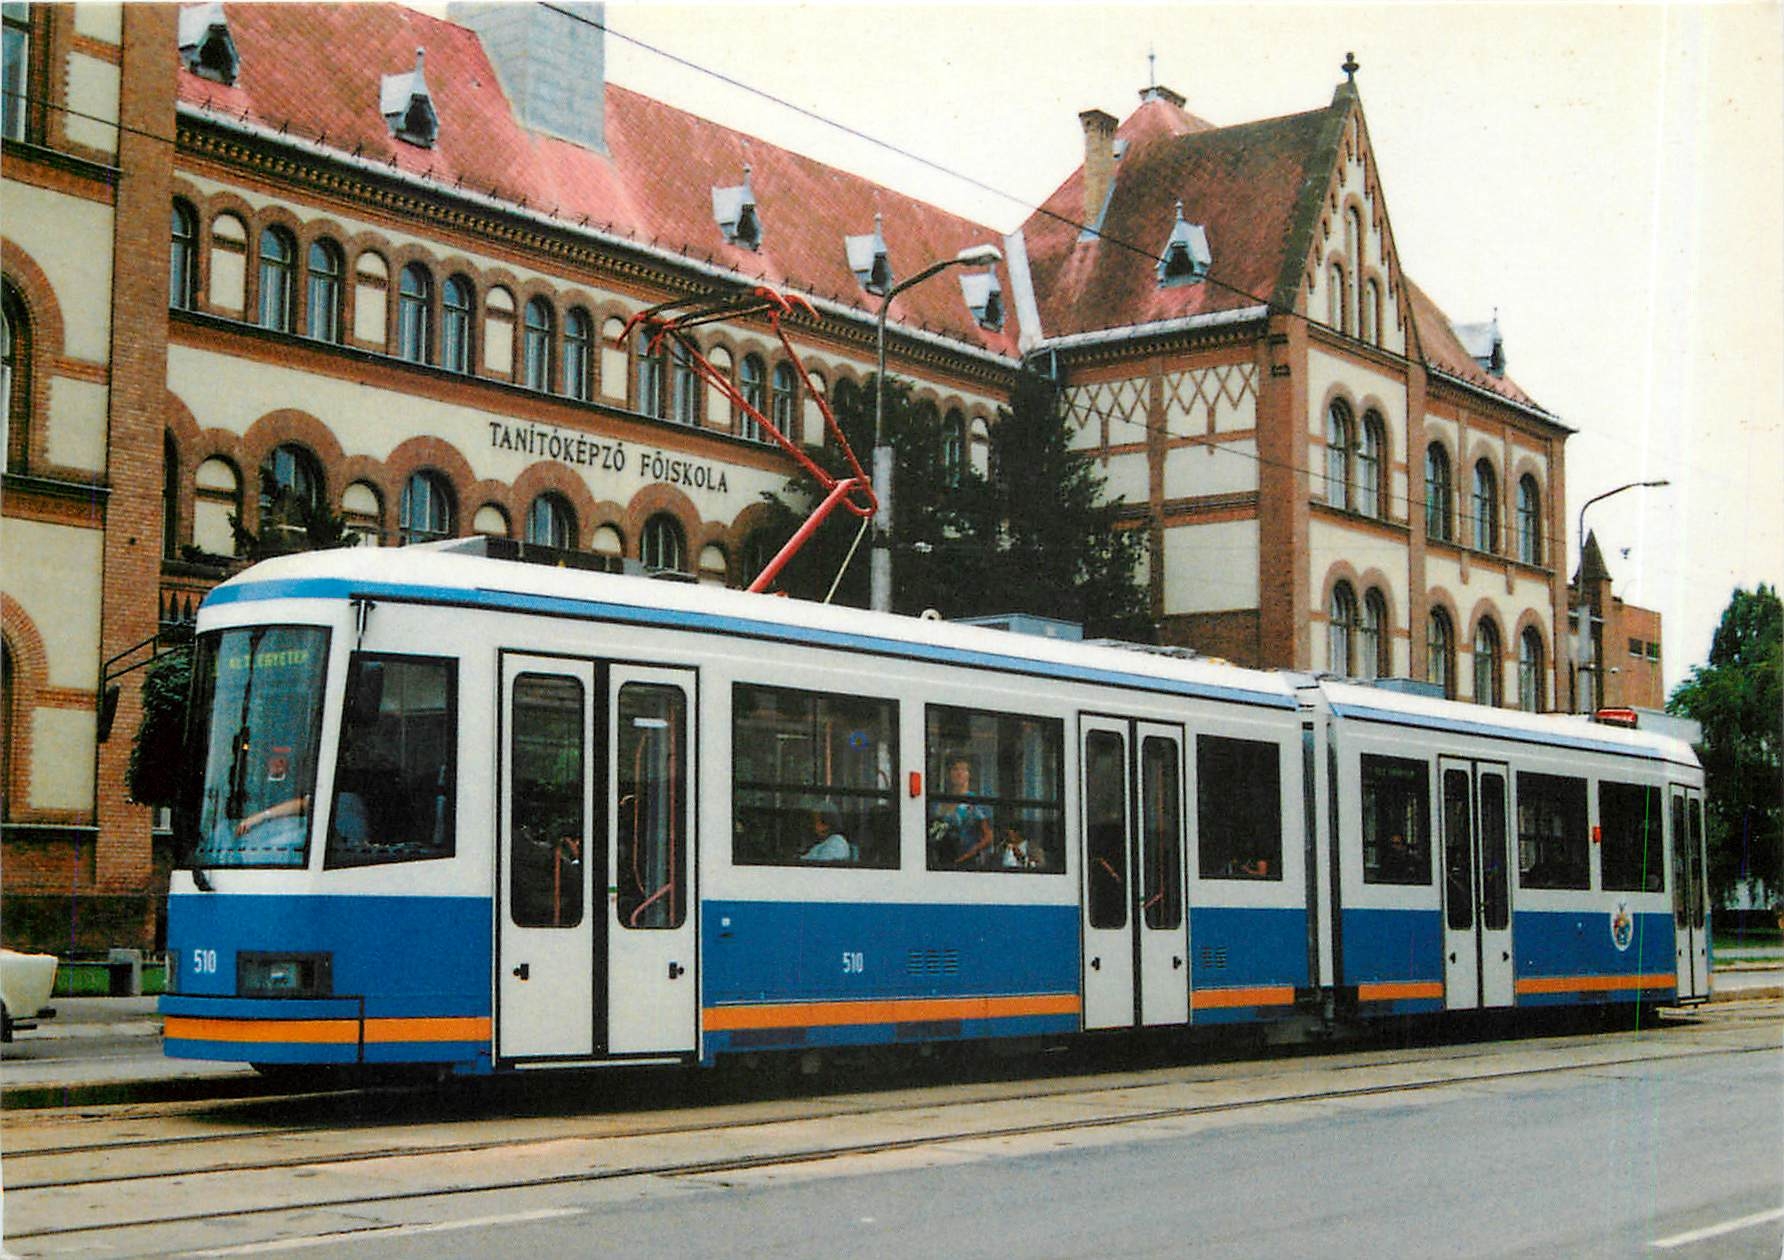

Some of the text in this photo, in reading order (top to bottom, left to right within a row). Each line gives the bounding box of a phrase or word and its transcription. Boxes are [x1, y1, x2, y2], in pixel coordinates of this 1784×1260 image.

[640, 451, 728, 493] FŐISKOLA
[193, 949, 217, 973] 510
[842, 952, 864, 973] 510
